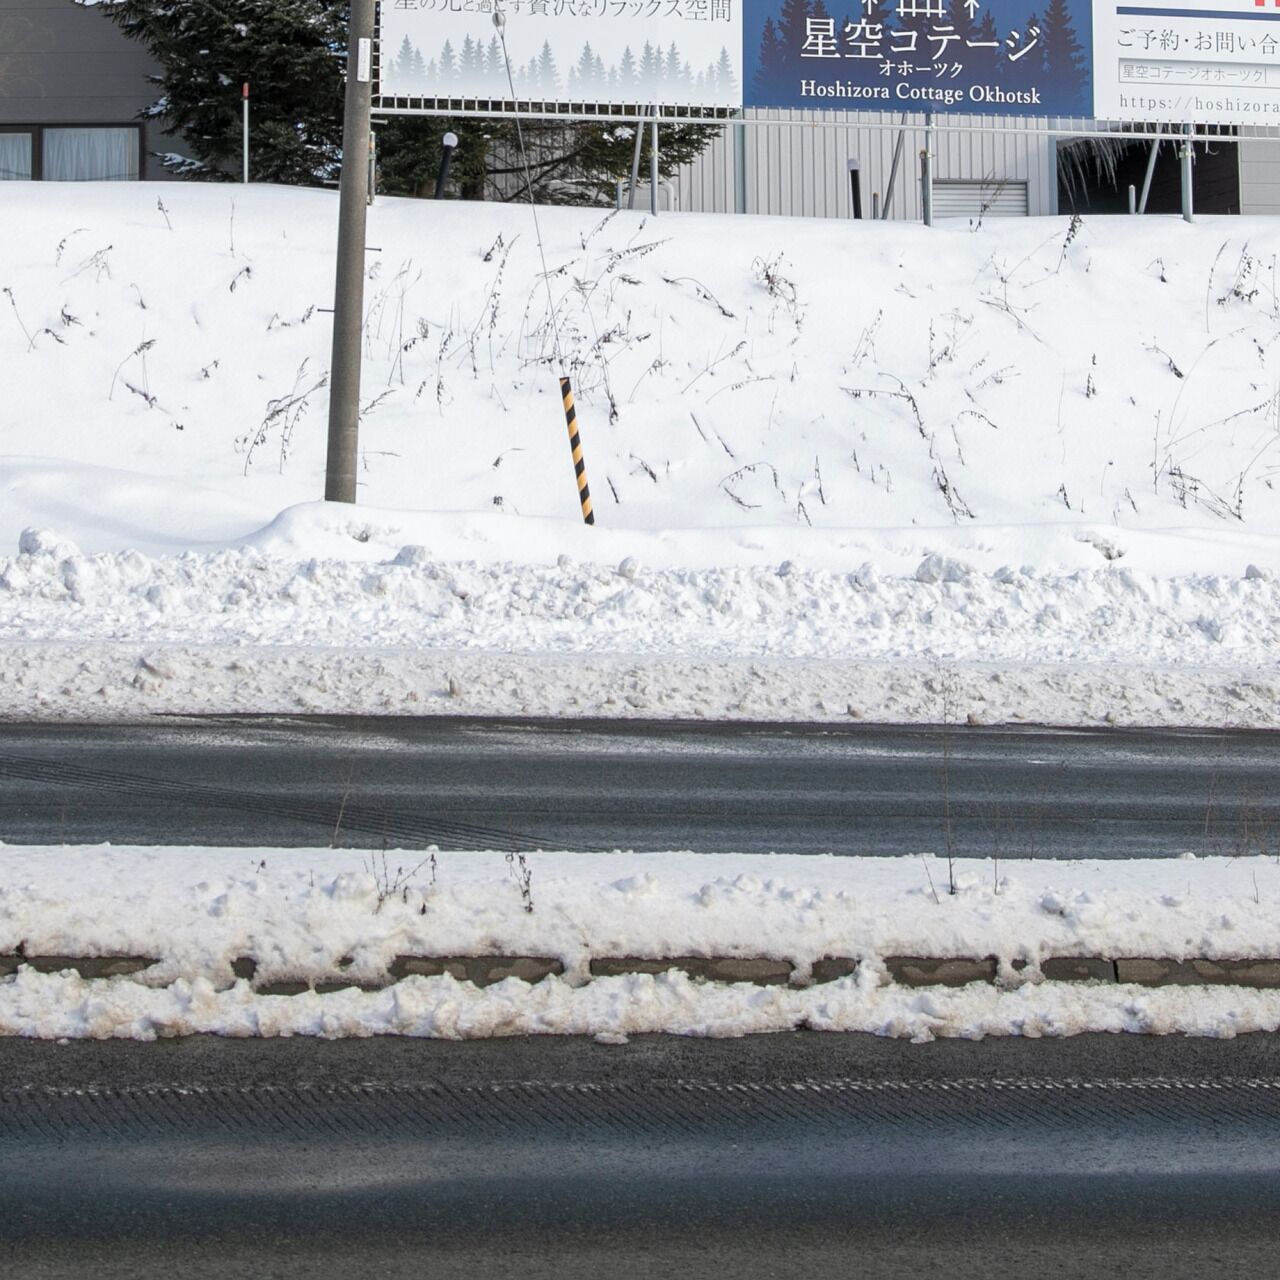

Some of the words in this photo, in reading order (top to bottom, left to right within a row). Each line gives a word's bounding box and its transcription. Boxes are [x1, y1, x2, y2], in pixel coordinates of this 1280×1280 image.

[800, 17, 1041, 62] 星空コテージ
[879, 59, 964, 79] オホーツク
[1122, 64, 1264, 83] 星空コテージオホーツク
[800, 79, 890, 99] Hoshizora
[896, 82, 964, 105] Cottage
[969, 85, 1041, 105] Okhotsk
